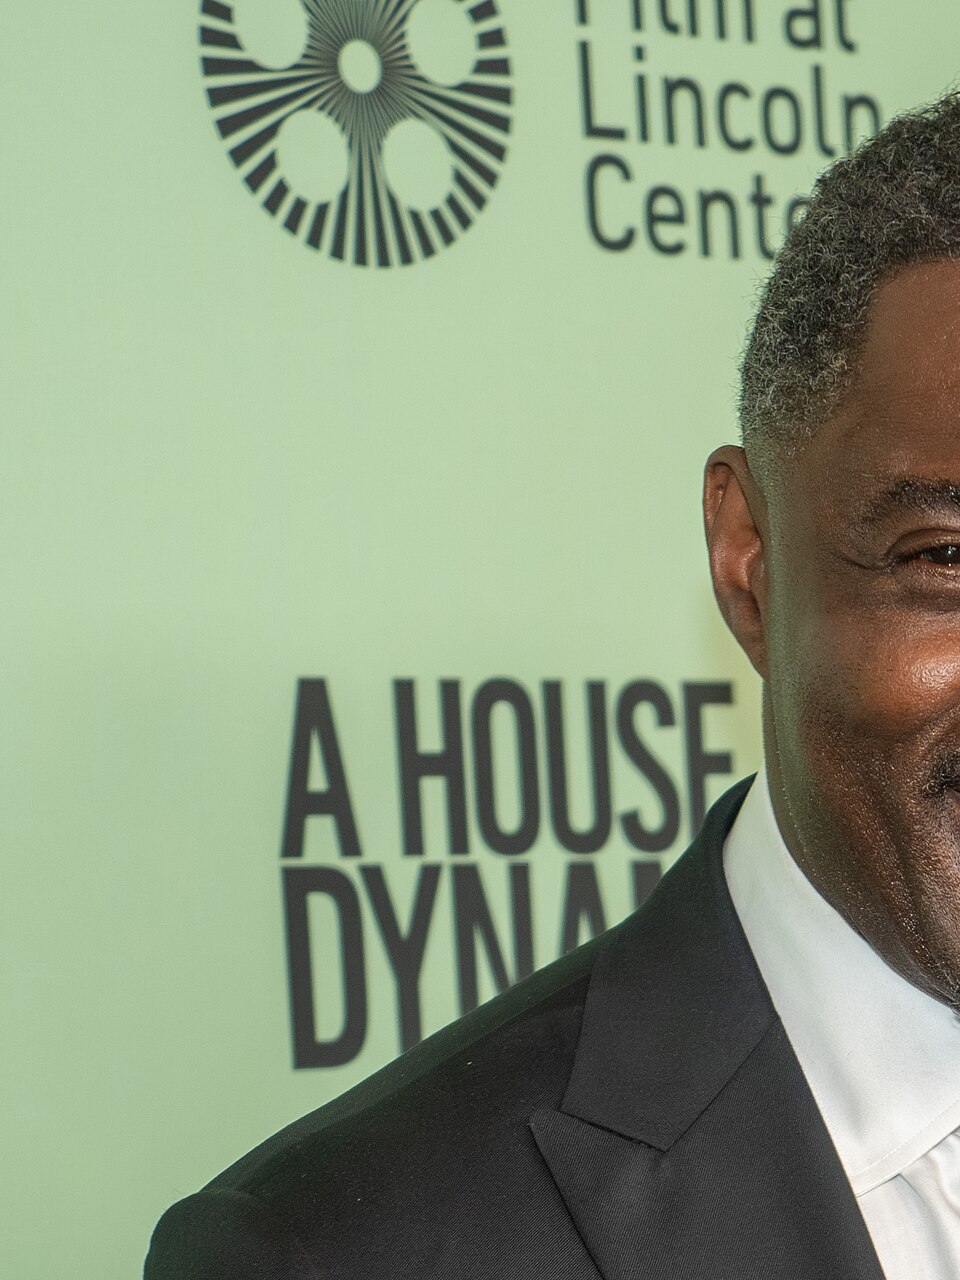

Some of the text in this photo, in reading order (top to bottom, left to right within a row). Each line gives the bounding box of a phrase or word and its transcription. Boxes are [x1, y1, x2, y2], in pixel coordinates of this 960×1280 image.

[578, 40, 882, 158] Lincoln
[279, 676, 736, 859] A HOUSE
